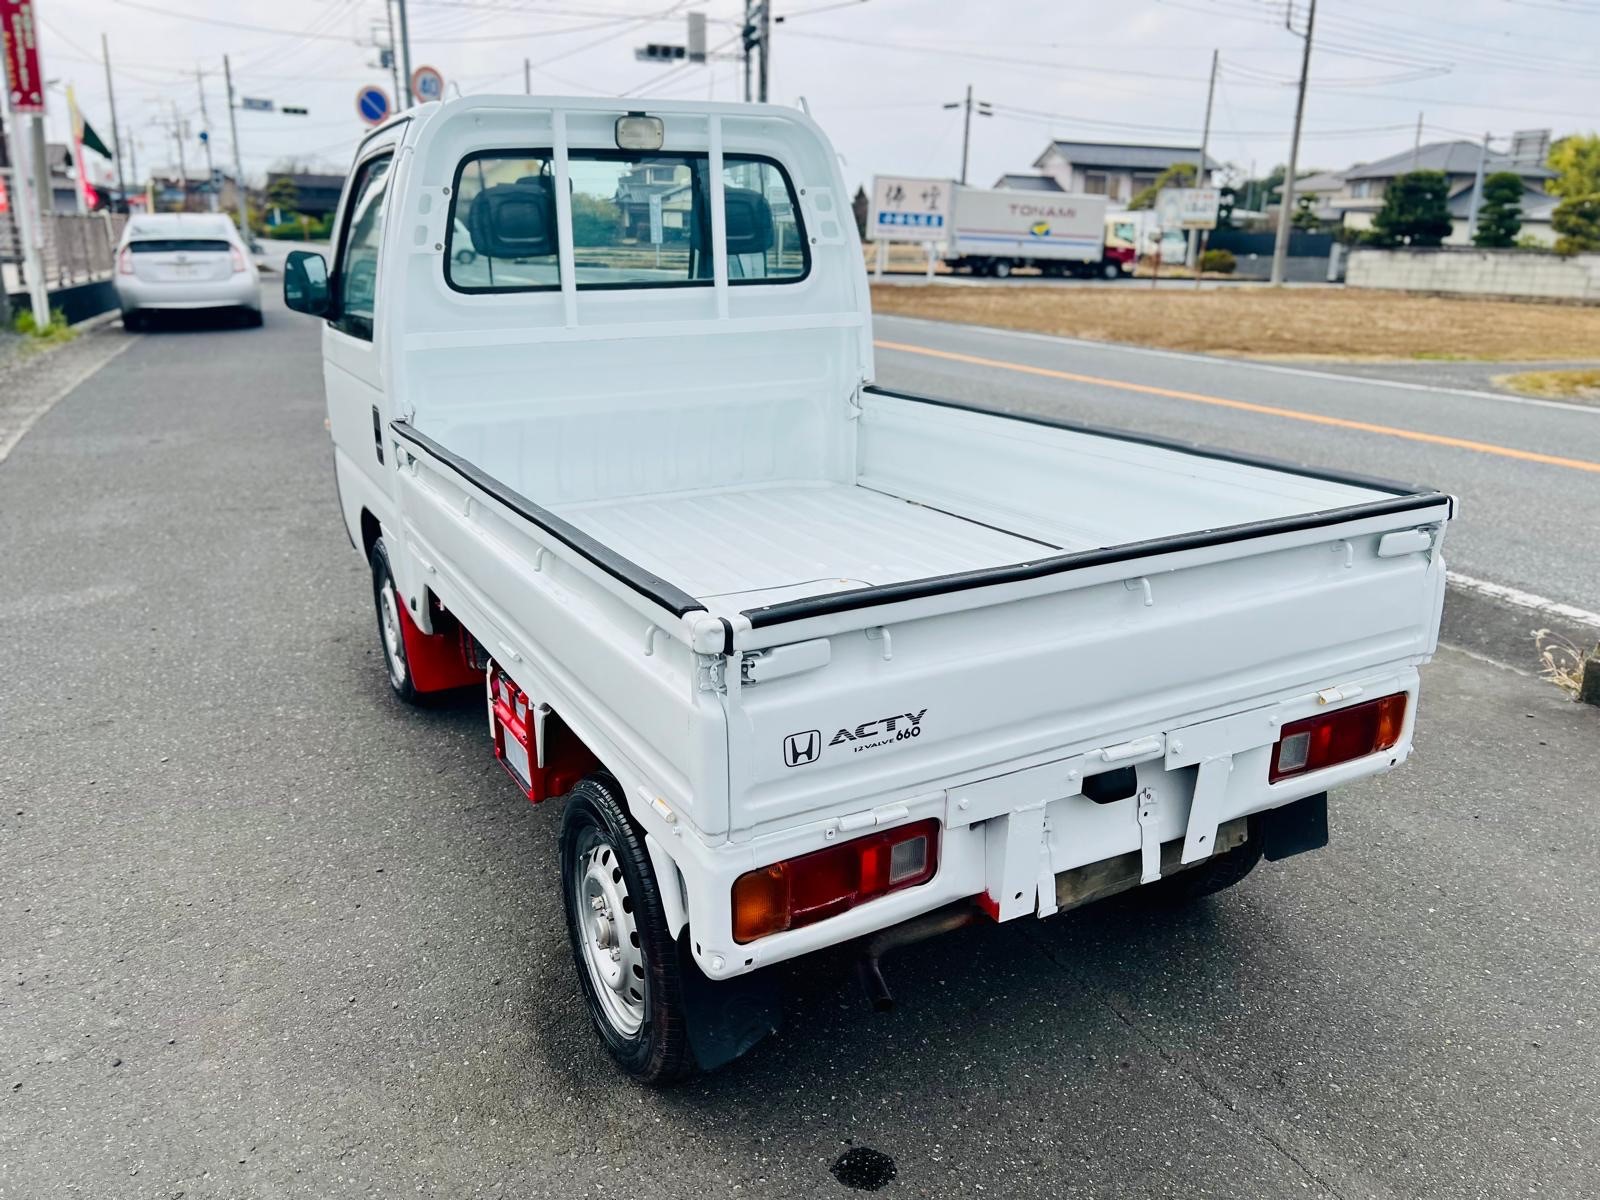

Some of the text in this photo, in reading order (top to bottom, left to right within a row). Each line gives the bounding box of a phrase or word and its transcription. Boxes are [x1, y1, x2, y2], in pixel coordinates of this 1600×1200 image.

[1009, 203, 1076, 218] TONAMI
[828, 708, 928, 747] ACTY
[895, 726, 921, 742] 660
